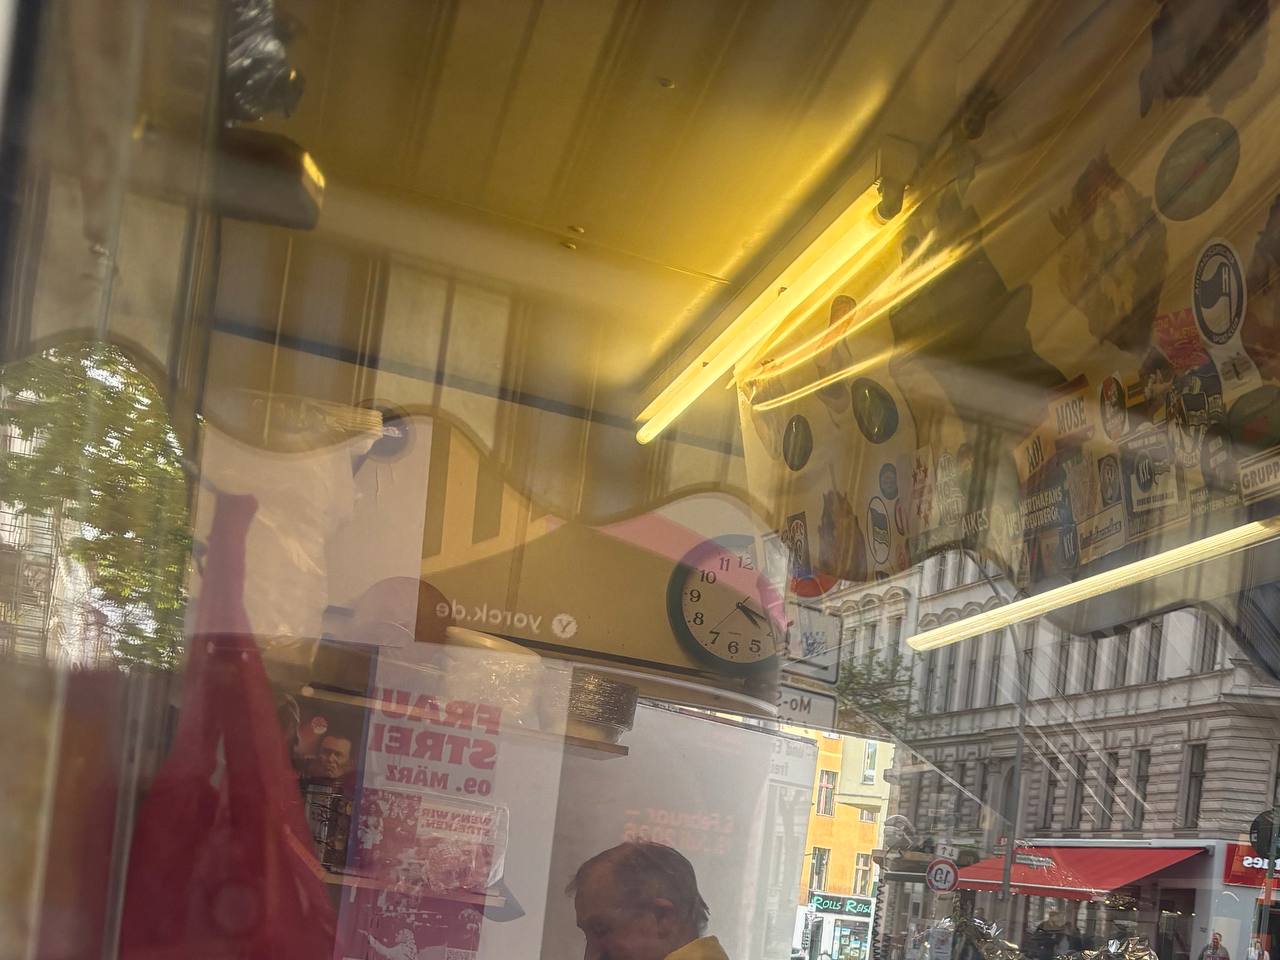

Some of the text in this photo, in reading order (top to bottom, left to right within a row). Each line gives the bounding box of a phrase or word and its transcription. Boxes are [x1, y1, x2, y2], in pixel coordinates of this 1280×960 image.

[720, 557, 731, 572] 11
[738, 555, 755, 571] 12
[700, 569, 717, 585] 10
[689, 588, 702, 603] 9
[692, 611, 705, 626] 8
[709, 629, 720, 645] 7
[727, 640, 739, 655] 6
[749, 639, 761, 654] 5
